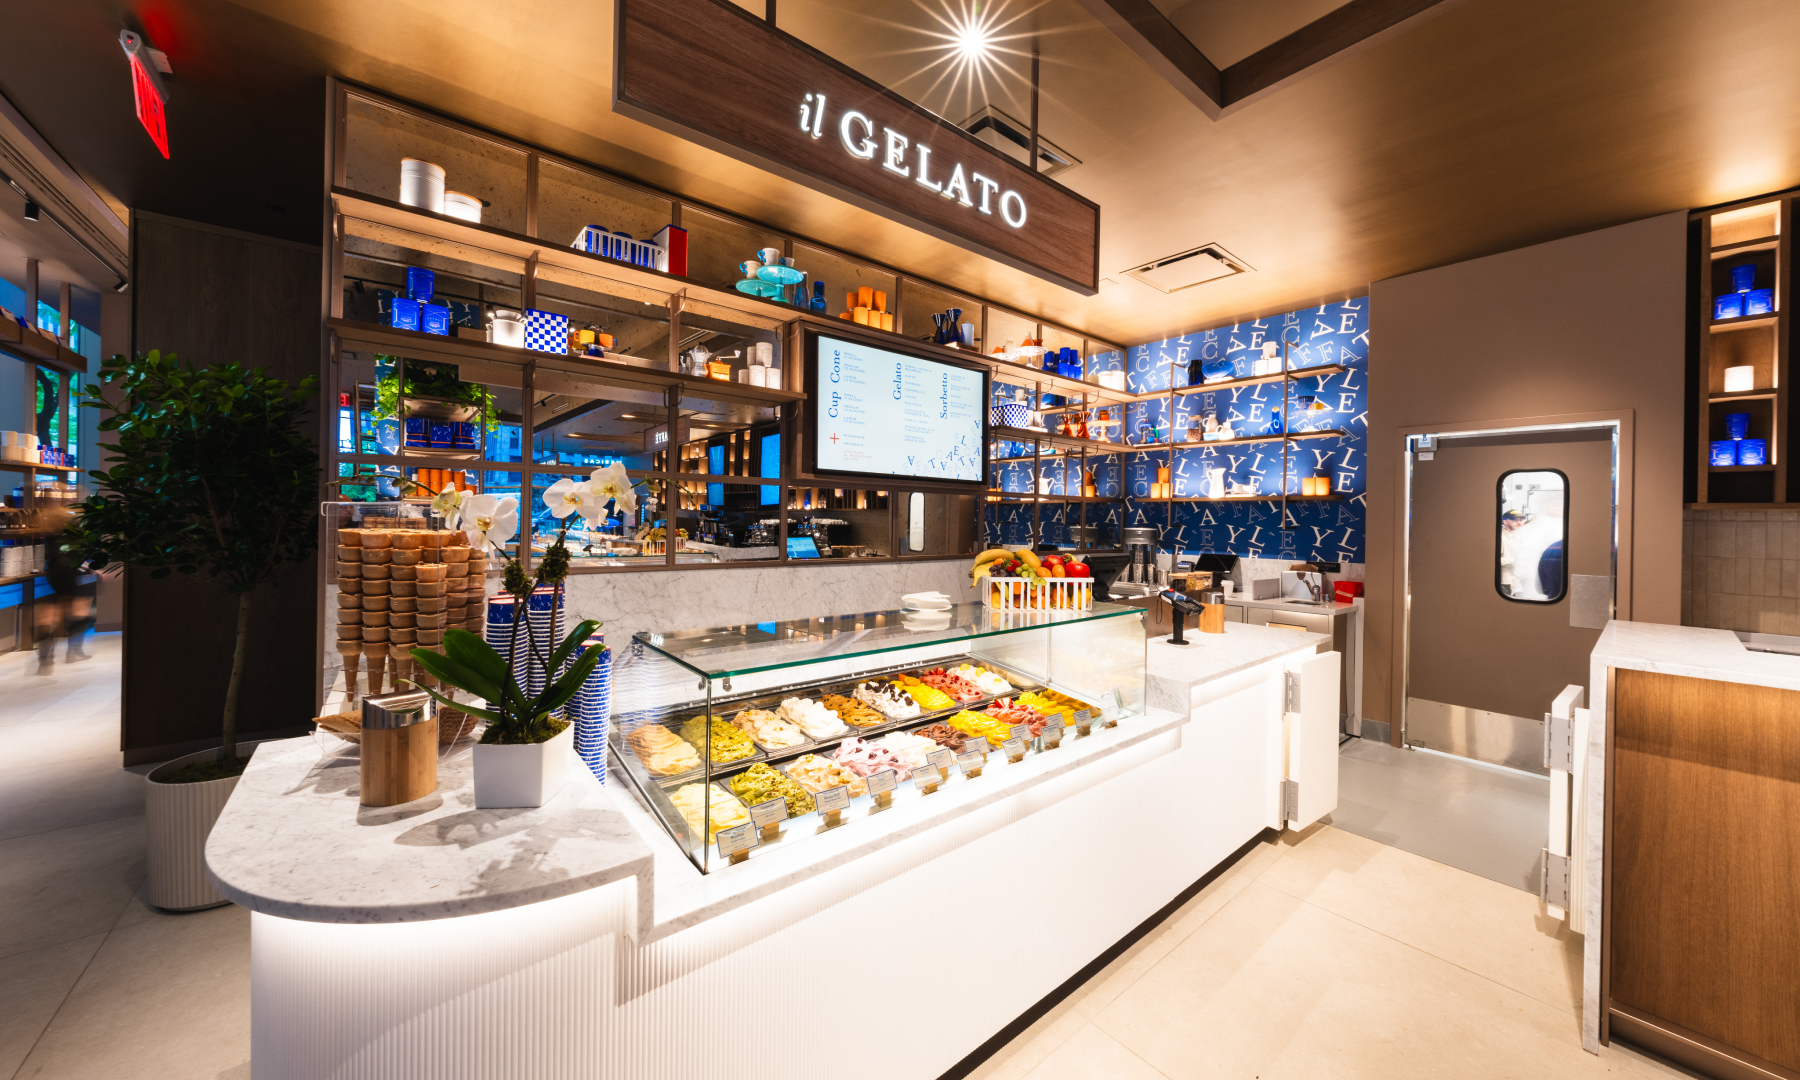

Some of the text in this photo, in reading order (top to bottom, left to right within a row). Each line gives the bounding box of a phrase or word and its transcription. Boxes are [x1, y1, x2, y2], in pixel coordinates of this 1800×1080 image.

[799, 93, 1027, 228] il GELATO
[829, 349, 841, 384] Cone
[892, 362, 902, 400] Gelato
[827, 391, 842, 418] Cup
[939, 372, 948, 420] Sorbetto
